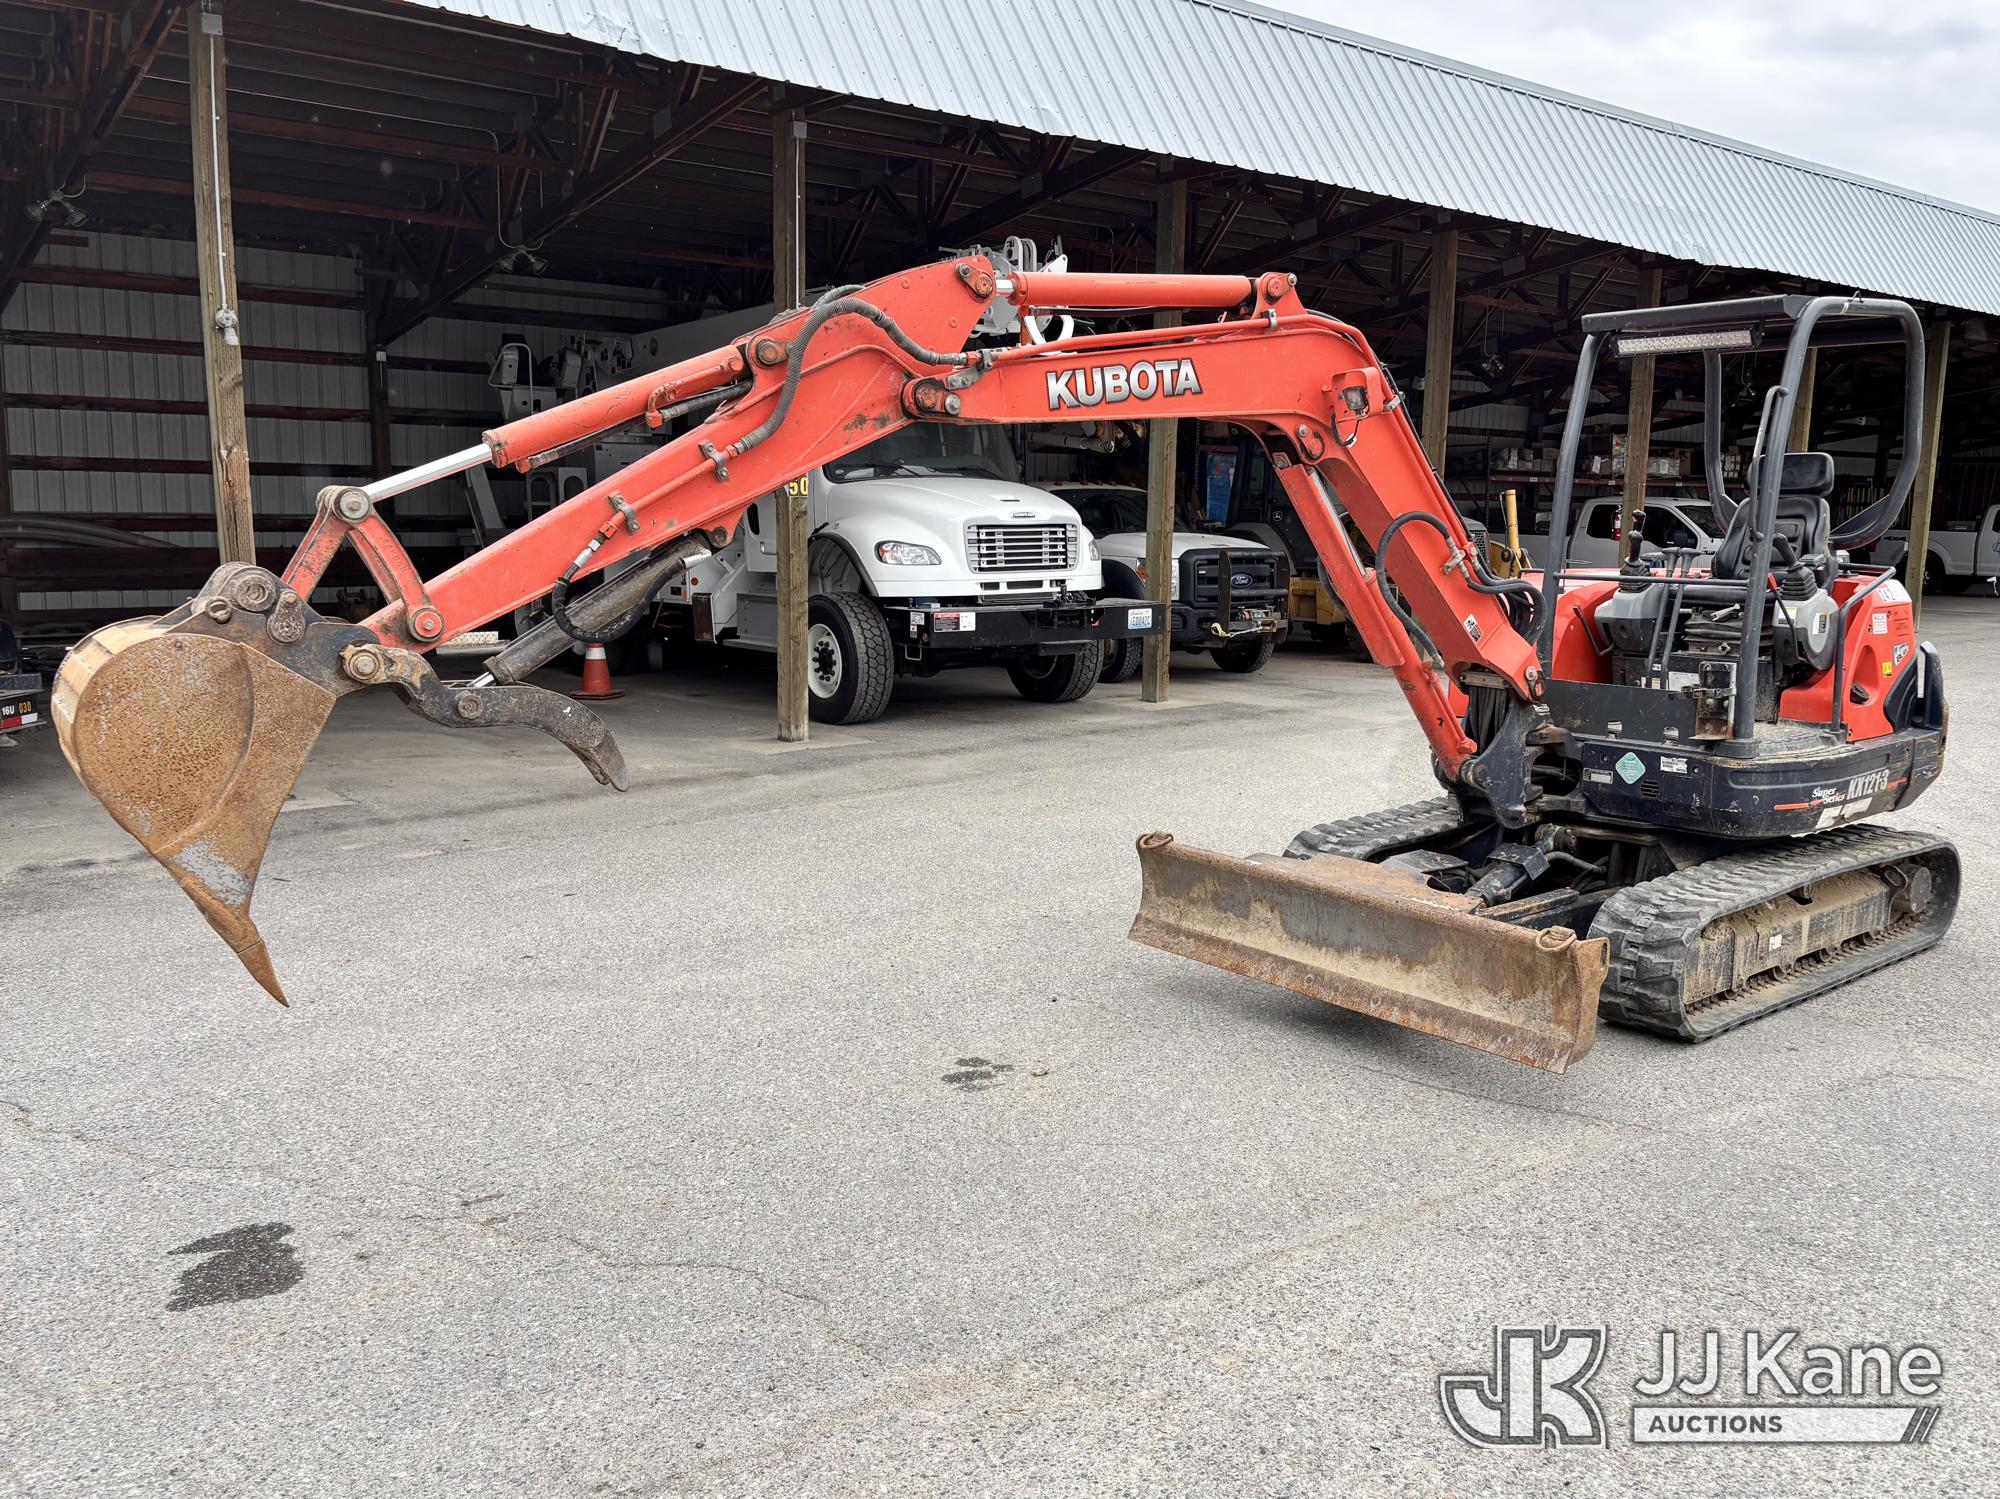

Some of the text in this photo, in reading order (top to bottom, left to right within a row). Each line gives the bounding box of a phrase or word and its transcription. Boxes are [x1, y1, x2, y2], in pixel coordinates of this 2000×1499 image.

[1046, 358, 1203, 410] KUBOTA
[1235, 576, 1249, 585] Ford
[1812, 787, 1838, 799] Super
[1823, 792, 1846, 804] Series
